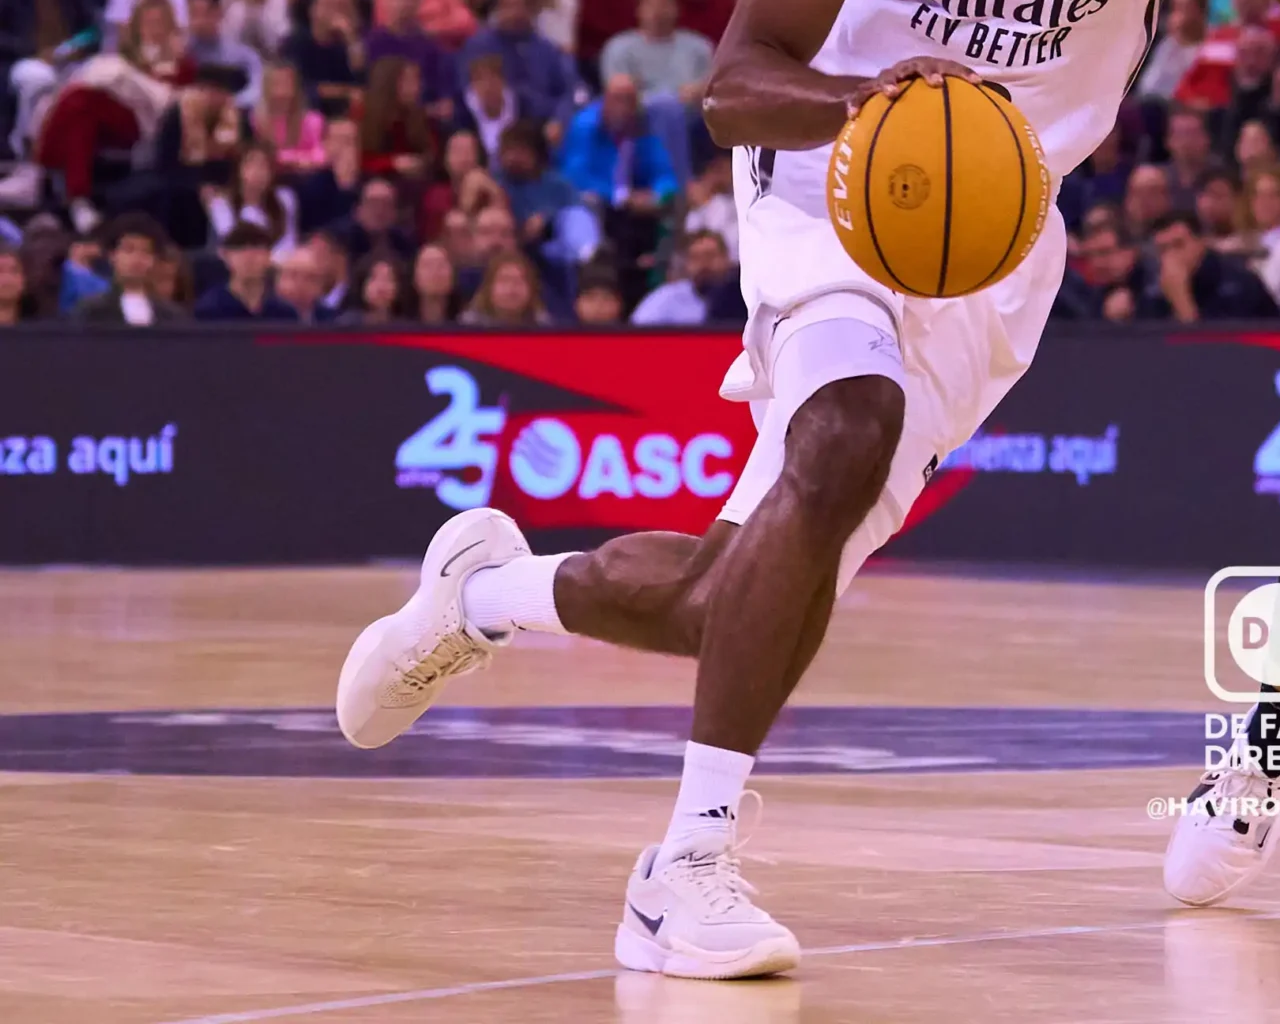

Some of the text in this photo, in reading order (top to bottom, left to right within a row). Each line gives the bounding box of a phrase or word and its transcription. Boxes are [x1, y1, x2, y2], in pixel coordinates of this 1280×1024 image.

[965, 22, 1072, 67] BETTER
[0, 422, 178, 487] za aquí
